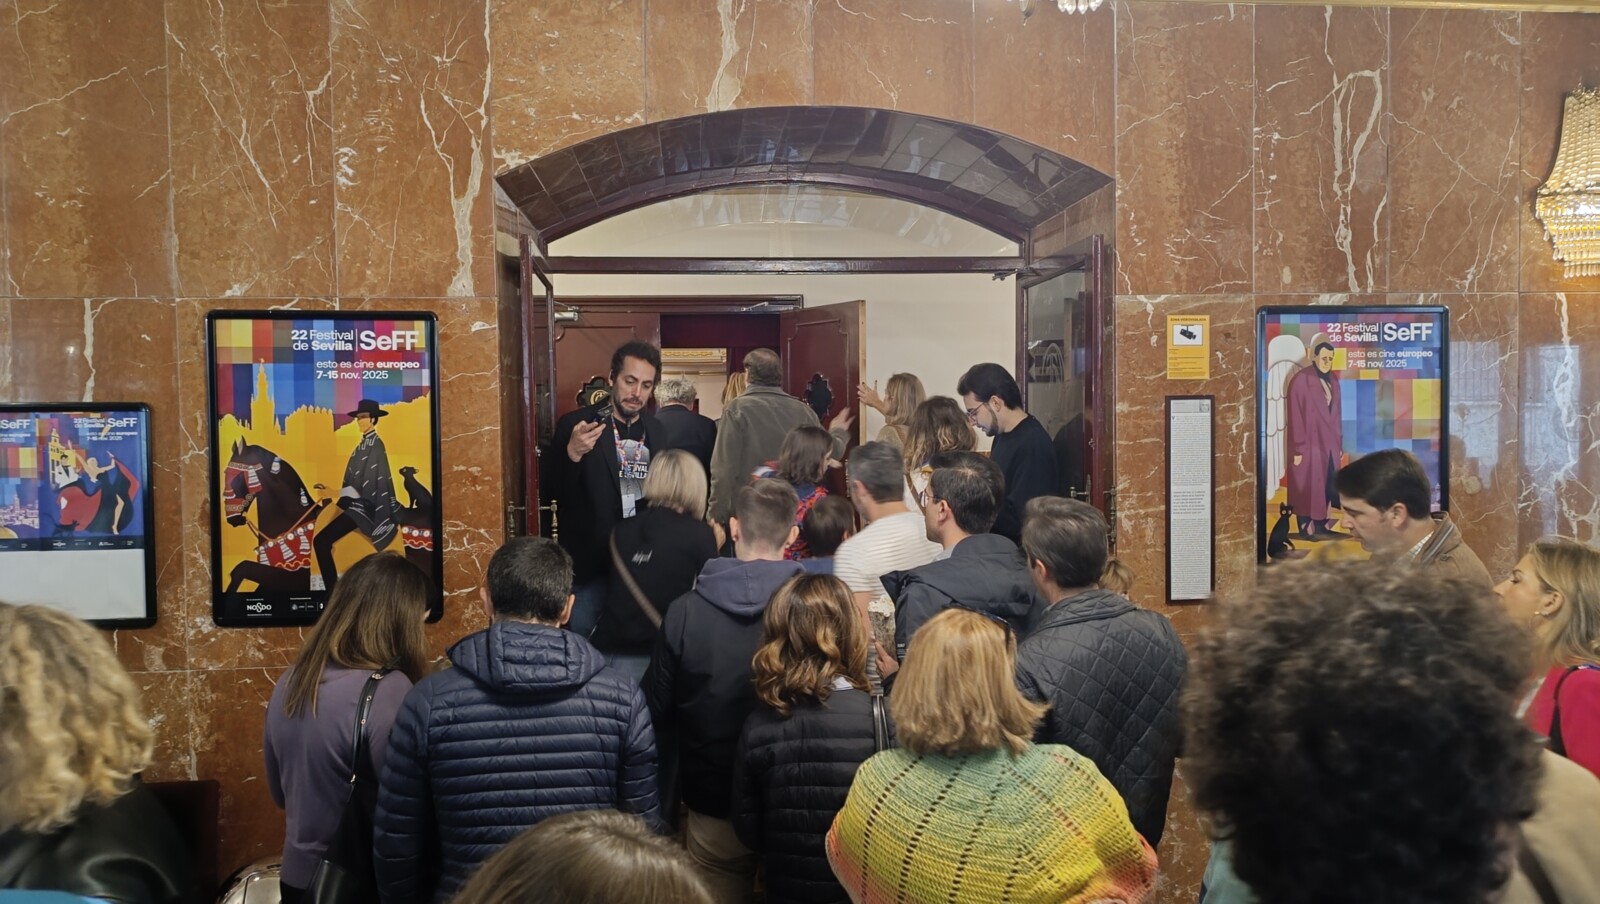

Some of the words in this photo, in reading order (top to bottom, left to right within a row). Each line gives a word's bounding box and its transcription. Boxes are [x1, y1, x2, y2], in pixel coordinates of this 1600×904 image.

[1327, 323, 1341, 333] 22
[1342, 322, 1379, 333] Festival
[1383, 322, 1434, 342] SeFF
[291, 330, 308, 340] 22
[309, 329, 354, 340] Festival
[1329, 333, 1342, 342] de
[1344, 332, 1378, 342] Sevilla
[293, 341, 309, 351] de
[311, 340, 353, 351] Sevilla
[359, 330, 420, 351] SeFF
[1348, 350, 1366, 358] esto
[1378, 350, 1396, 358] cine
[1397, 350, 1433, 359] europeo
[316, 361, 338, 369] esto
[340, 361, 352, 369] es
[353, 360, 375, 369] cine
[376, 361, 420, 371] europeo
[1348, 359, 1366, 368] 7-15
[1367, 360, 1385, 368] nov.
[1385, 359, 1408, 368] 2025
[316, 370, 339, 379] 7-15
[340, 371, 360, 380] nov.
[362, 370, 389, 380] 2025
[107, 417, 138, 428] SeFF
